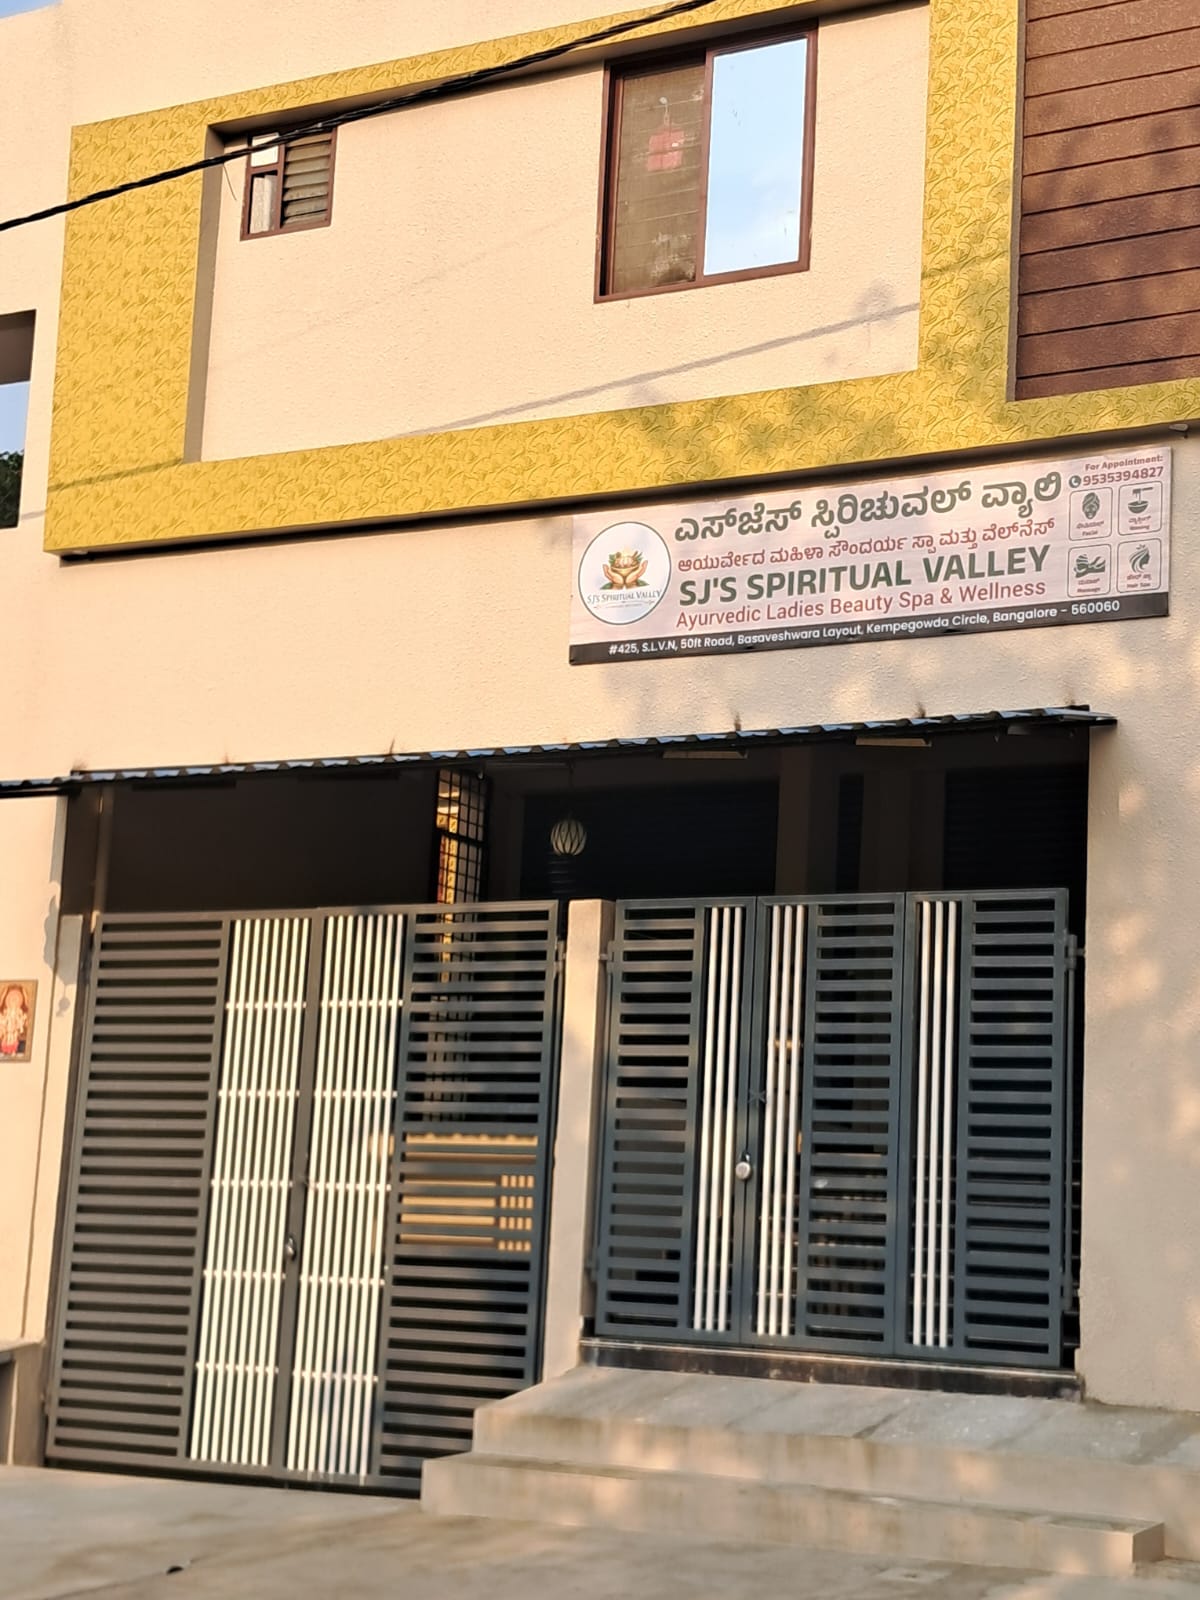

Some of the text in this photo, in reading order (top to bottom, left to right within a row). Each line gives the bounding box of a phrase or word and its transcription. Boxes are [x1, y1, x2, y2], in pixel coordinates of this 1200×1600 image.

[1083, 466, 1164, 486] 9535394827
[1085, 454, 1164, 472] For Appointment:
[811, 481, 972, 539] ಸ್ಪಿರಿಚುವಲ್
[981, 471, 1062, 518] ವ್ಯಾಲಿ
[770, 546, 823, 564] ಮಹಿಳಾ
[828, 536, 907, 558] ಸೌಂದರ್ಯ
[912, 533, 937, 554] ಸ್ಪಾ
[939, 527, 978, 549] ಮತ್ತು
[679, 544, 1051, 606] SJ'S SPIRITUAL VALLEY
[608, 643, 640, 656] #425,
[680, 637, 702, 648] 50ft
[704, 635, 735, 648] Road,
[737, 625, 821, 645] Basaveshwara
[823, 624, 864, 640] Layout,
[866, 617, 950, 634] Kempegowda
[952, 611, 990, 626] Circle,
[993, 607, 1058, 624] Bangalore
[1071, 600, 1121, 615] 560060
[676, 581, 1046, 631] Ayurvedic Ladies Beauty Spa & Wellness
